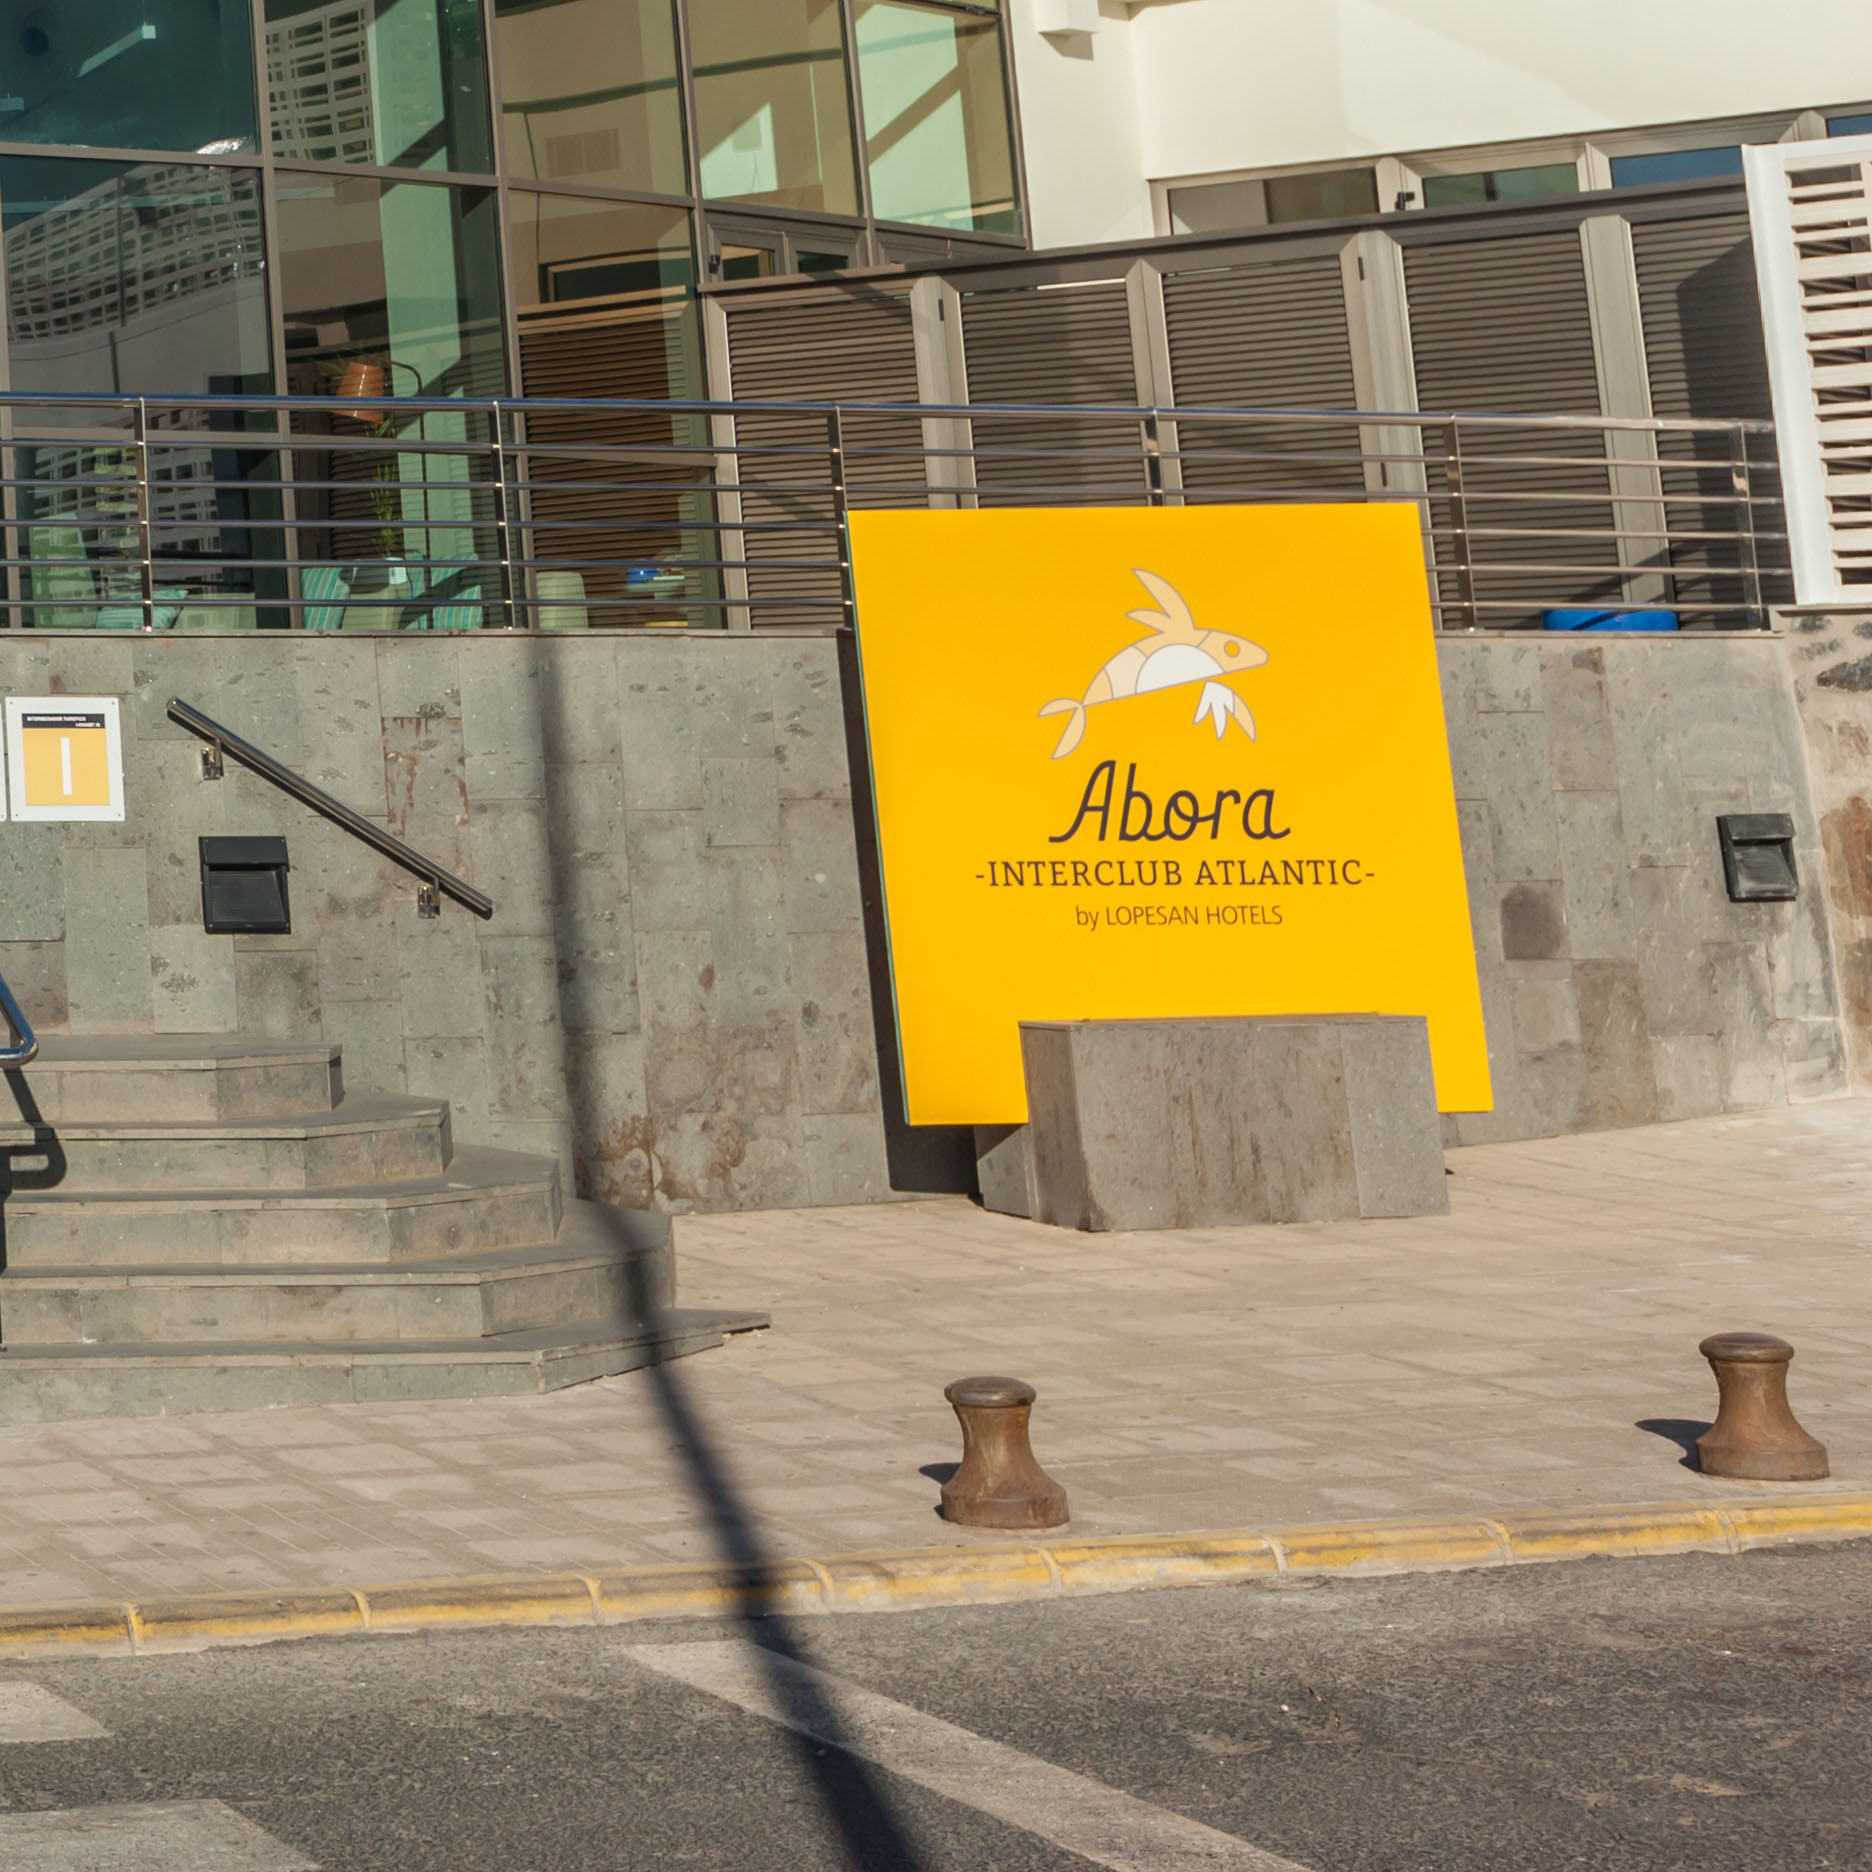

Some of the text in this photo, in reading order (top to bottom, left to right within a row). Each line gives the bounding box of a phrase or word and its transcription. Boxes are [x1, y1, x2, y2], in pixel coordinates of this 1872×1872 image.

[1048, 759, 1291, 844] Abora
[1075, 905, 1283, 932] by LOPESAN HOTELS
